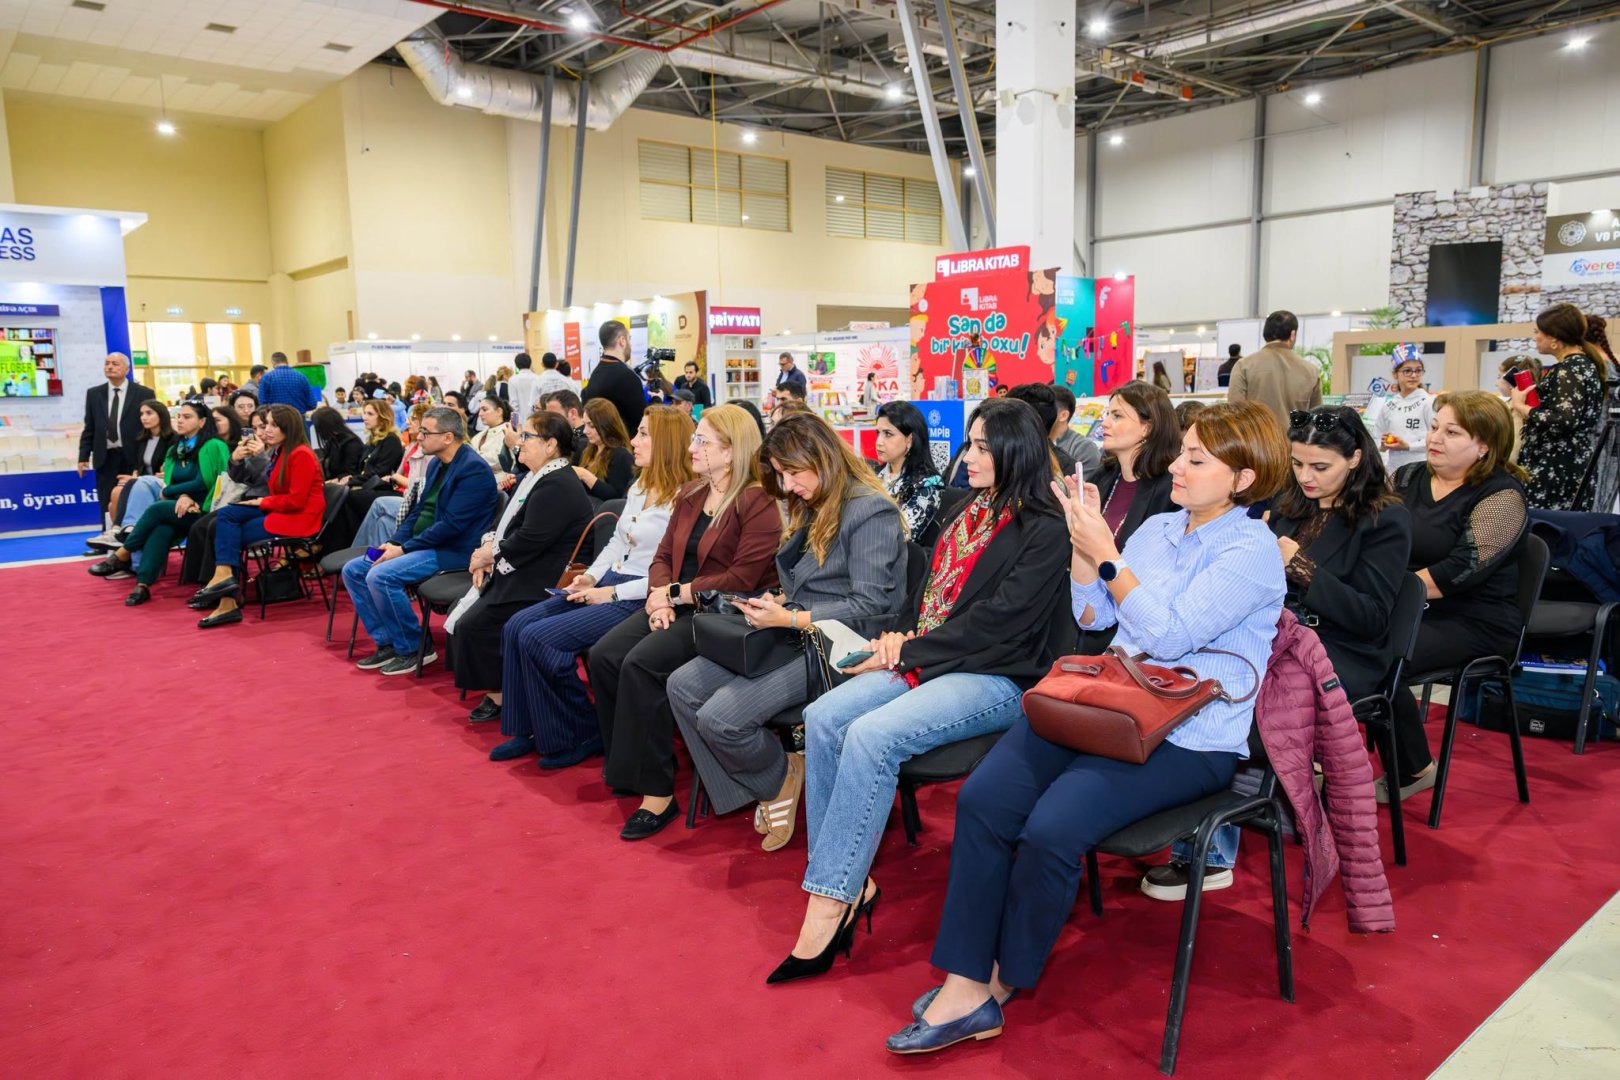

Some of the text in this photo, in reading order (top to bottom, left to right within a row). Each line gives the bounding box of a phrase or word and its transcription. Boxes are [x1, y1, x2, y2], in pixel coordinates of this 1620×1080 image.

[856, 380, 899, 392] ZKA
[1406, 418, 1420, 429] 92
[23, 493, 77, 511] öyrən
